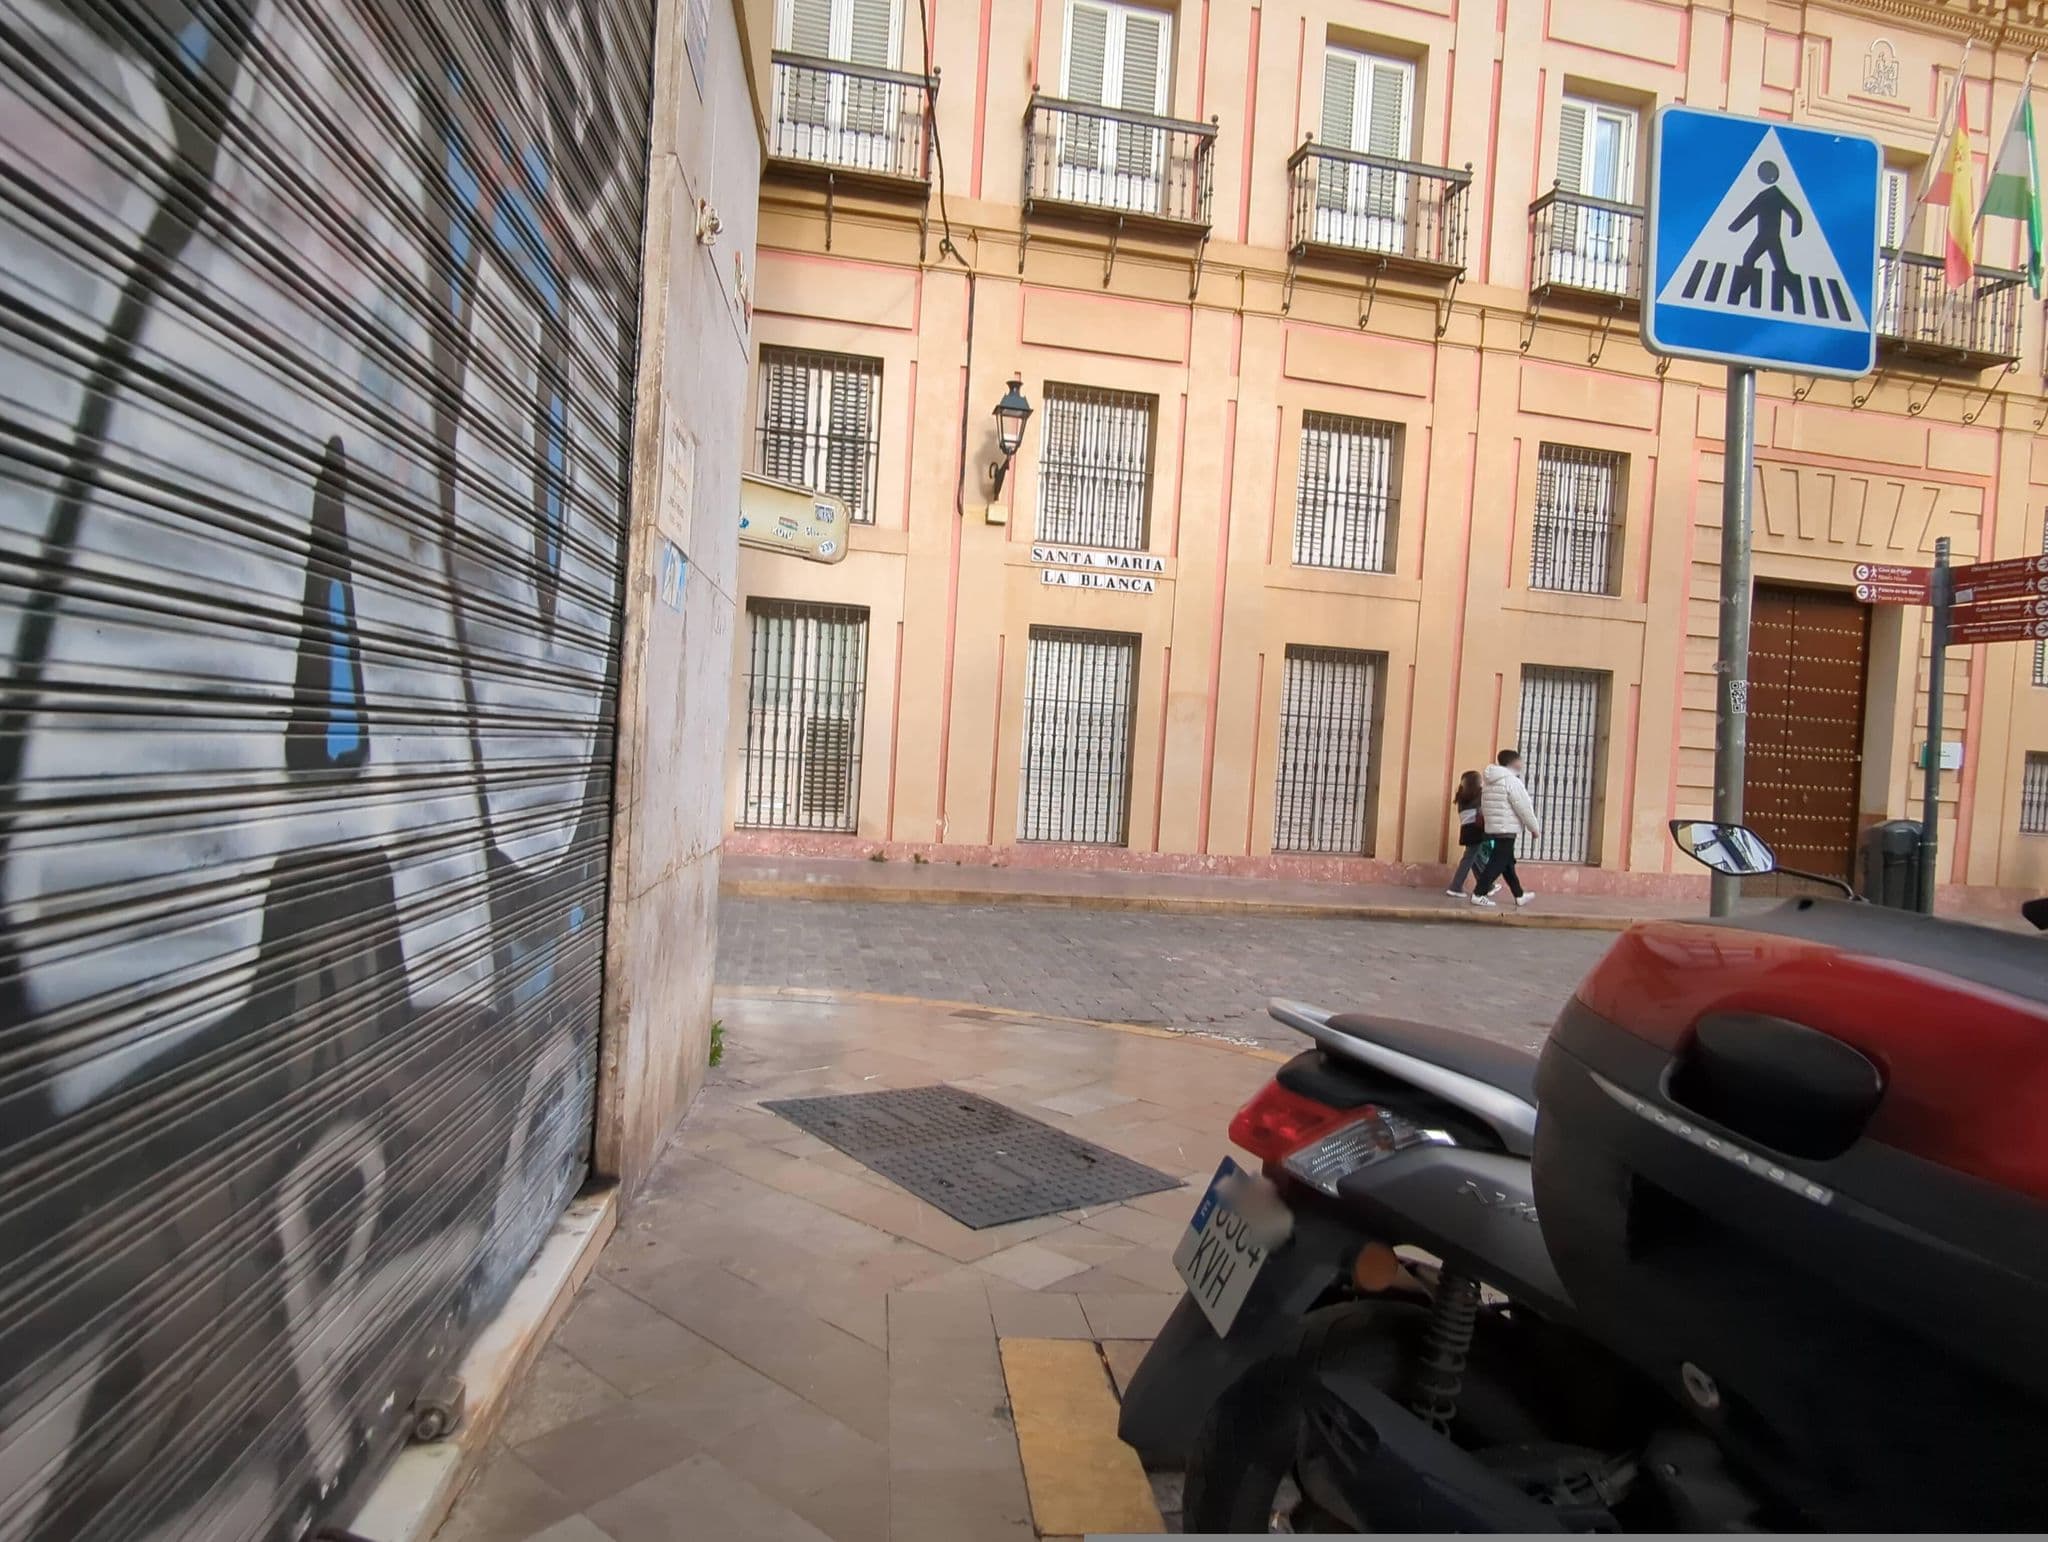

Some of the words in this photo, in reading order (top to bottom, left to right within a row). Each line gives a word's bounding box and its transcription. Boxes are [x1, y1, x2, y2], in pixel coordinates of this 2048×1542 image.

[1033, 548, 1093, 565] SANTA
[1106, 554, 1163, 572] MARIA
[1043, 570, 1067, 584] LA
[1081, 573, 1153, 593] BLANCA
[1634, 1101, 1825, 1202] TOPCASE
[1187, 1227, 1237, 1309] KVH
